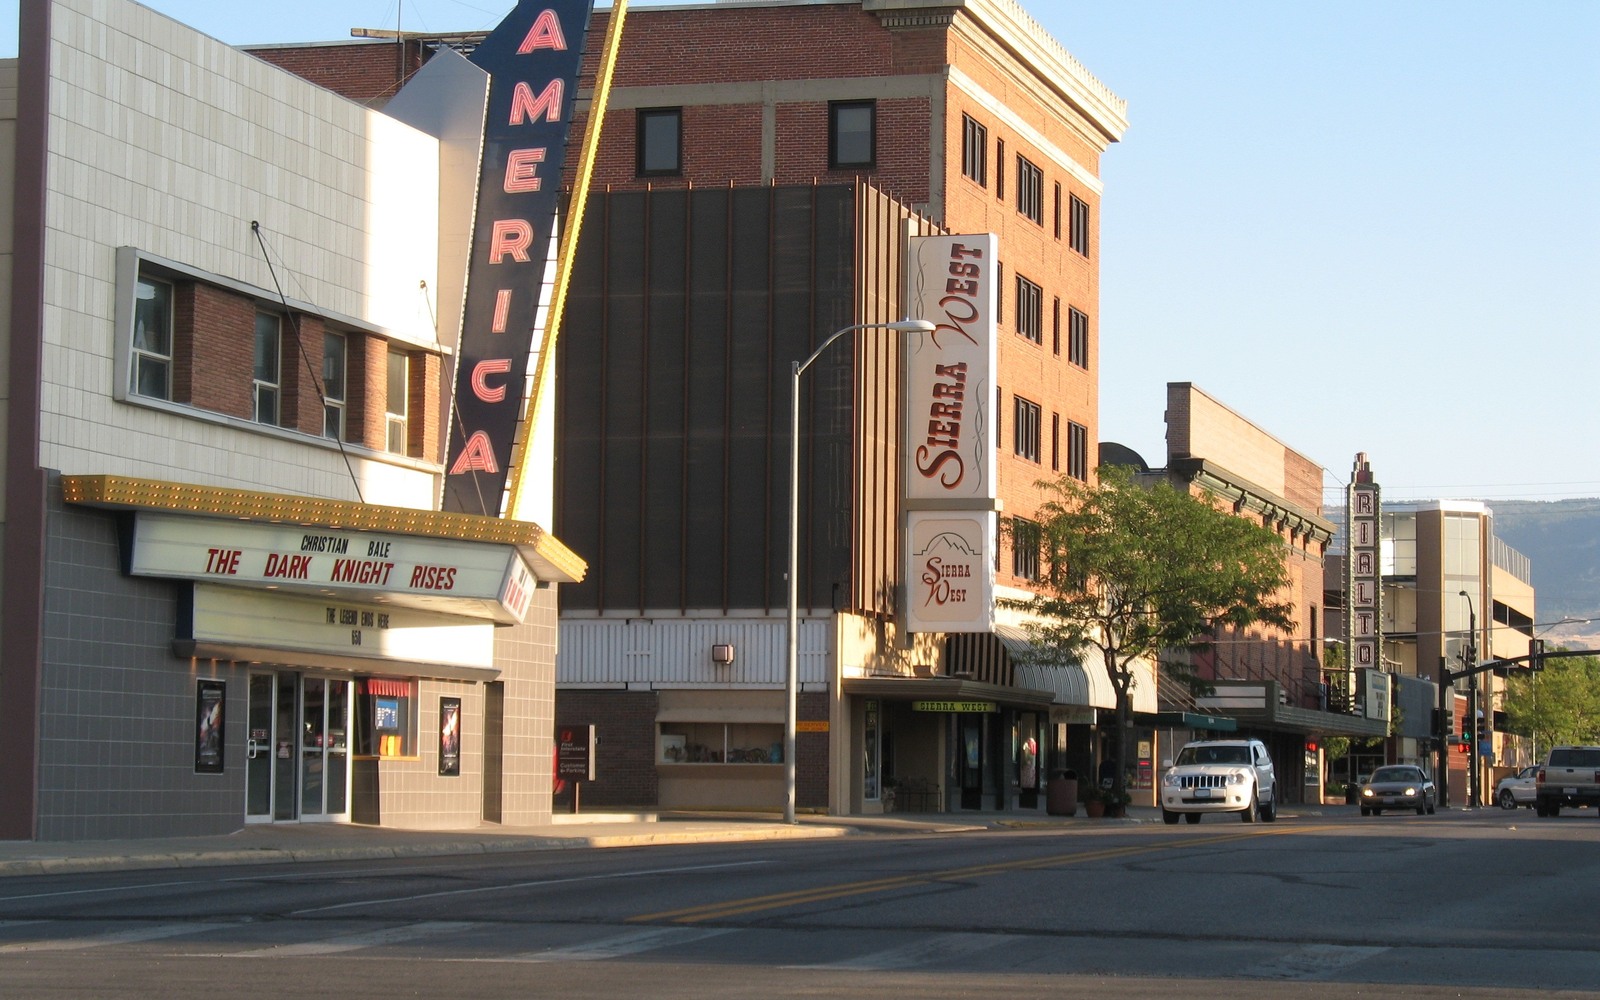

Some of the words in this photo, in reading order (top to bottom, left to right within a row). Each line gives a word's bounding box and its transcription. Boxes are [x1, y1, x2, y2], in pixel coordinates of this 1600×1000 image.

[449, 9, 568, 475] AMERICA
[301, 535, 349, 554] CHRISTIAN
[367, 541, 391, 558] BALE
[206, 549, 242, 575] THE
[263, 554, 312, 579] DARK
[330, 559, 394, 585] KNIGHT
[409, 565, 457, 590] RISES
[1356, 492, 1373, 664] RIALTO
[326, 607, 336, 625] THE
[340, 609, 358, 626] LEGEND
[361, 611, 374, 627] ENDS
[377, 613, 390, 629] HERE
[920, 702, 956, 711] SIERRA
[961, 703, 988, 711] WEST
